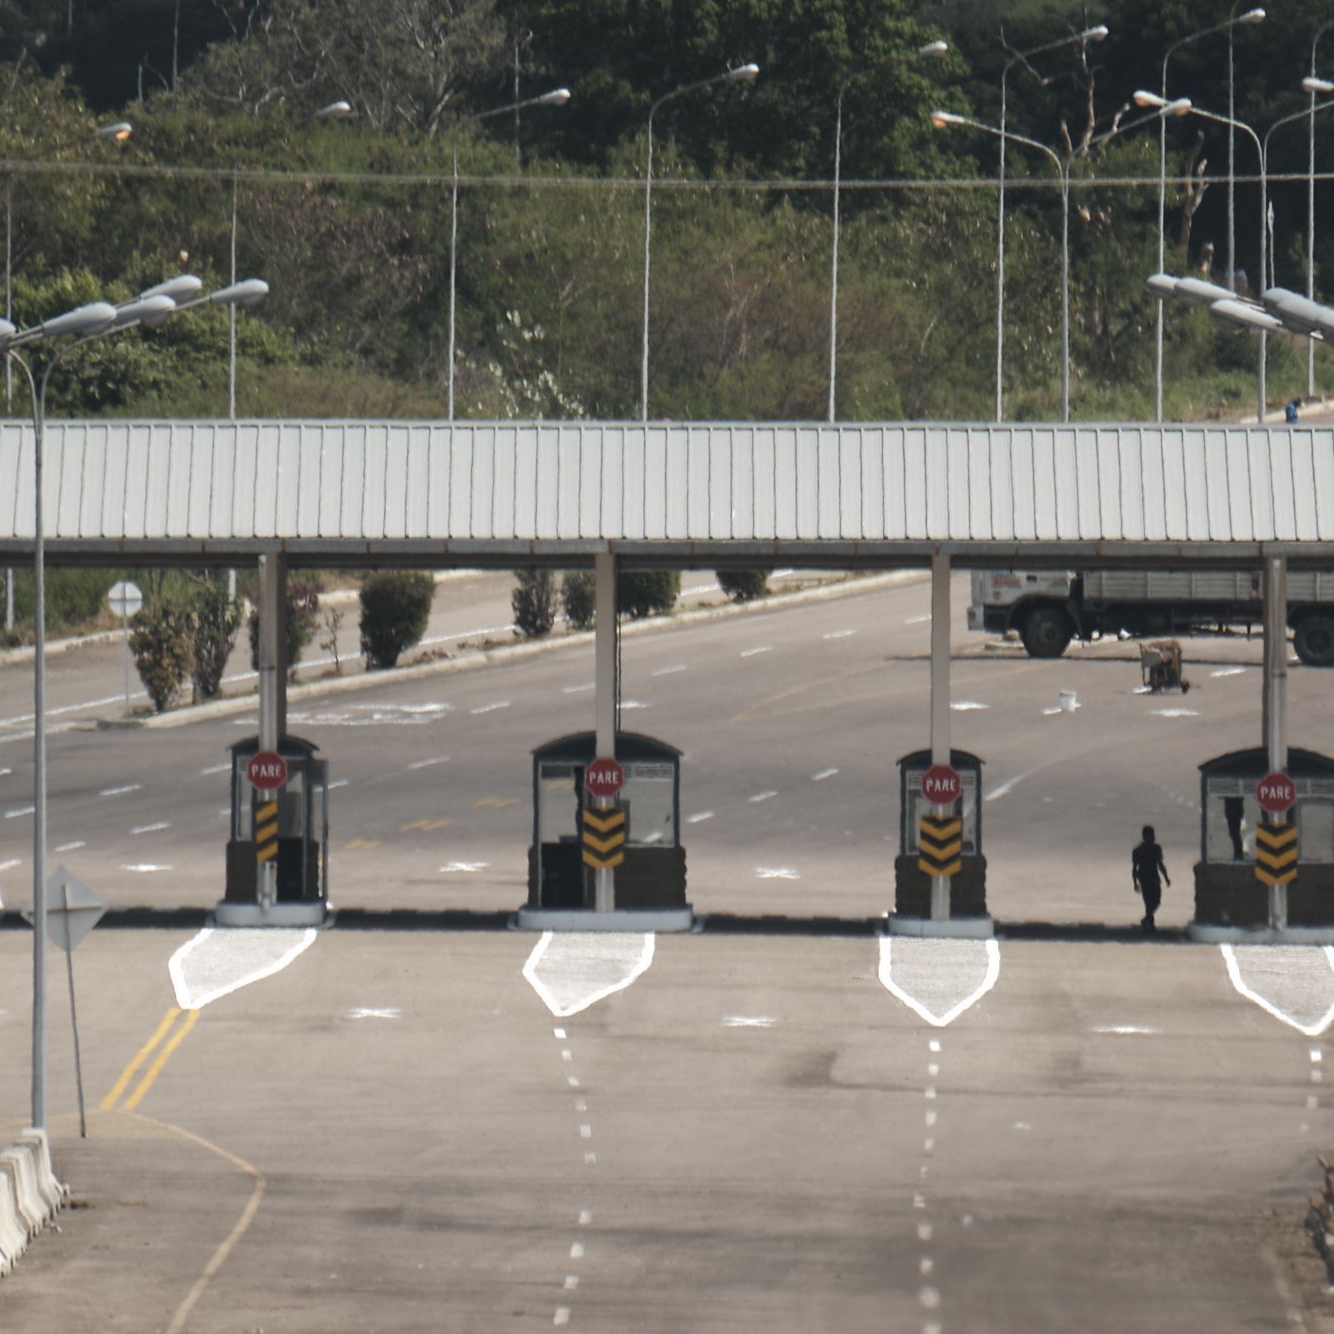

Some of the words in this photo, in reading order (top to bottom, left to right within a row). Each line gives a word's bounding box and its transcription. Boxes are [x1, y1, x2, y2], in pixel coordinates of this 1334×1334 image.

[251, 763, 282, 778] PARE
[588, 770, 620, 785] PARE
[925, 778, 957, 792] PARE
[1260, 785, 1292, 800] PARE
